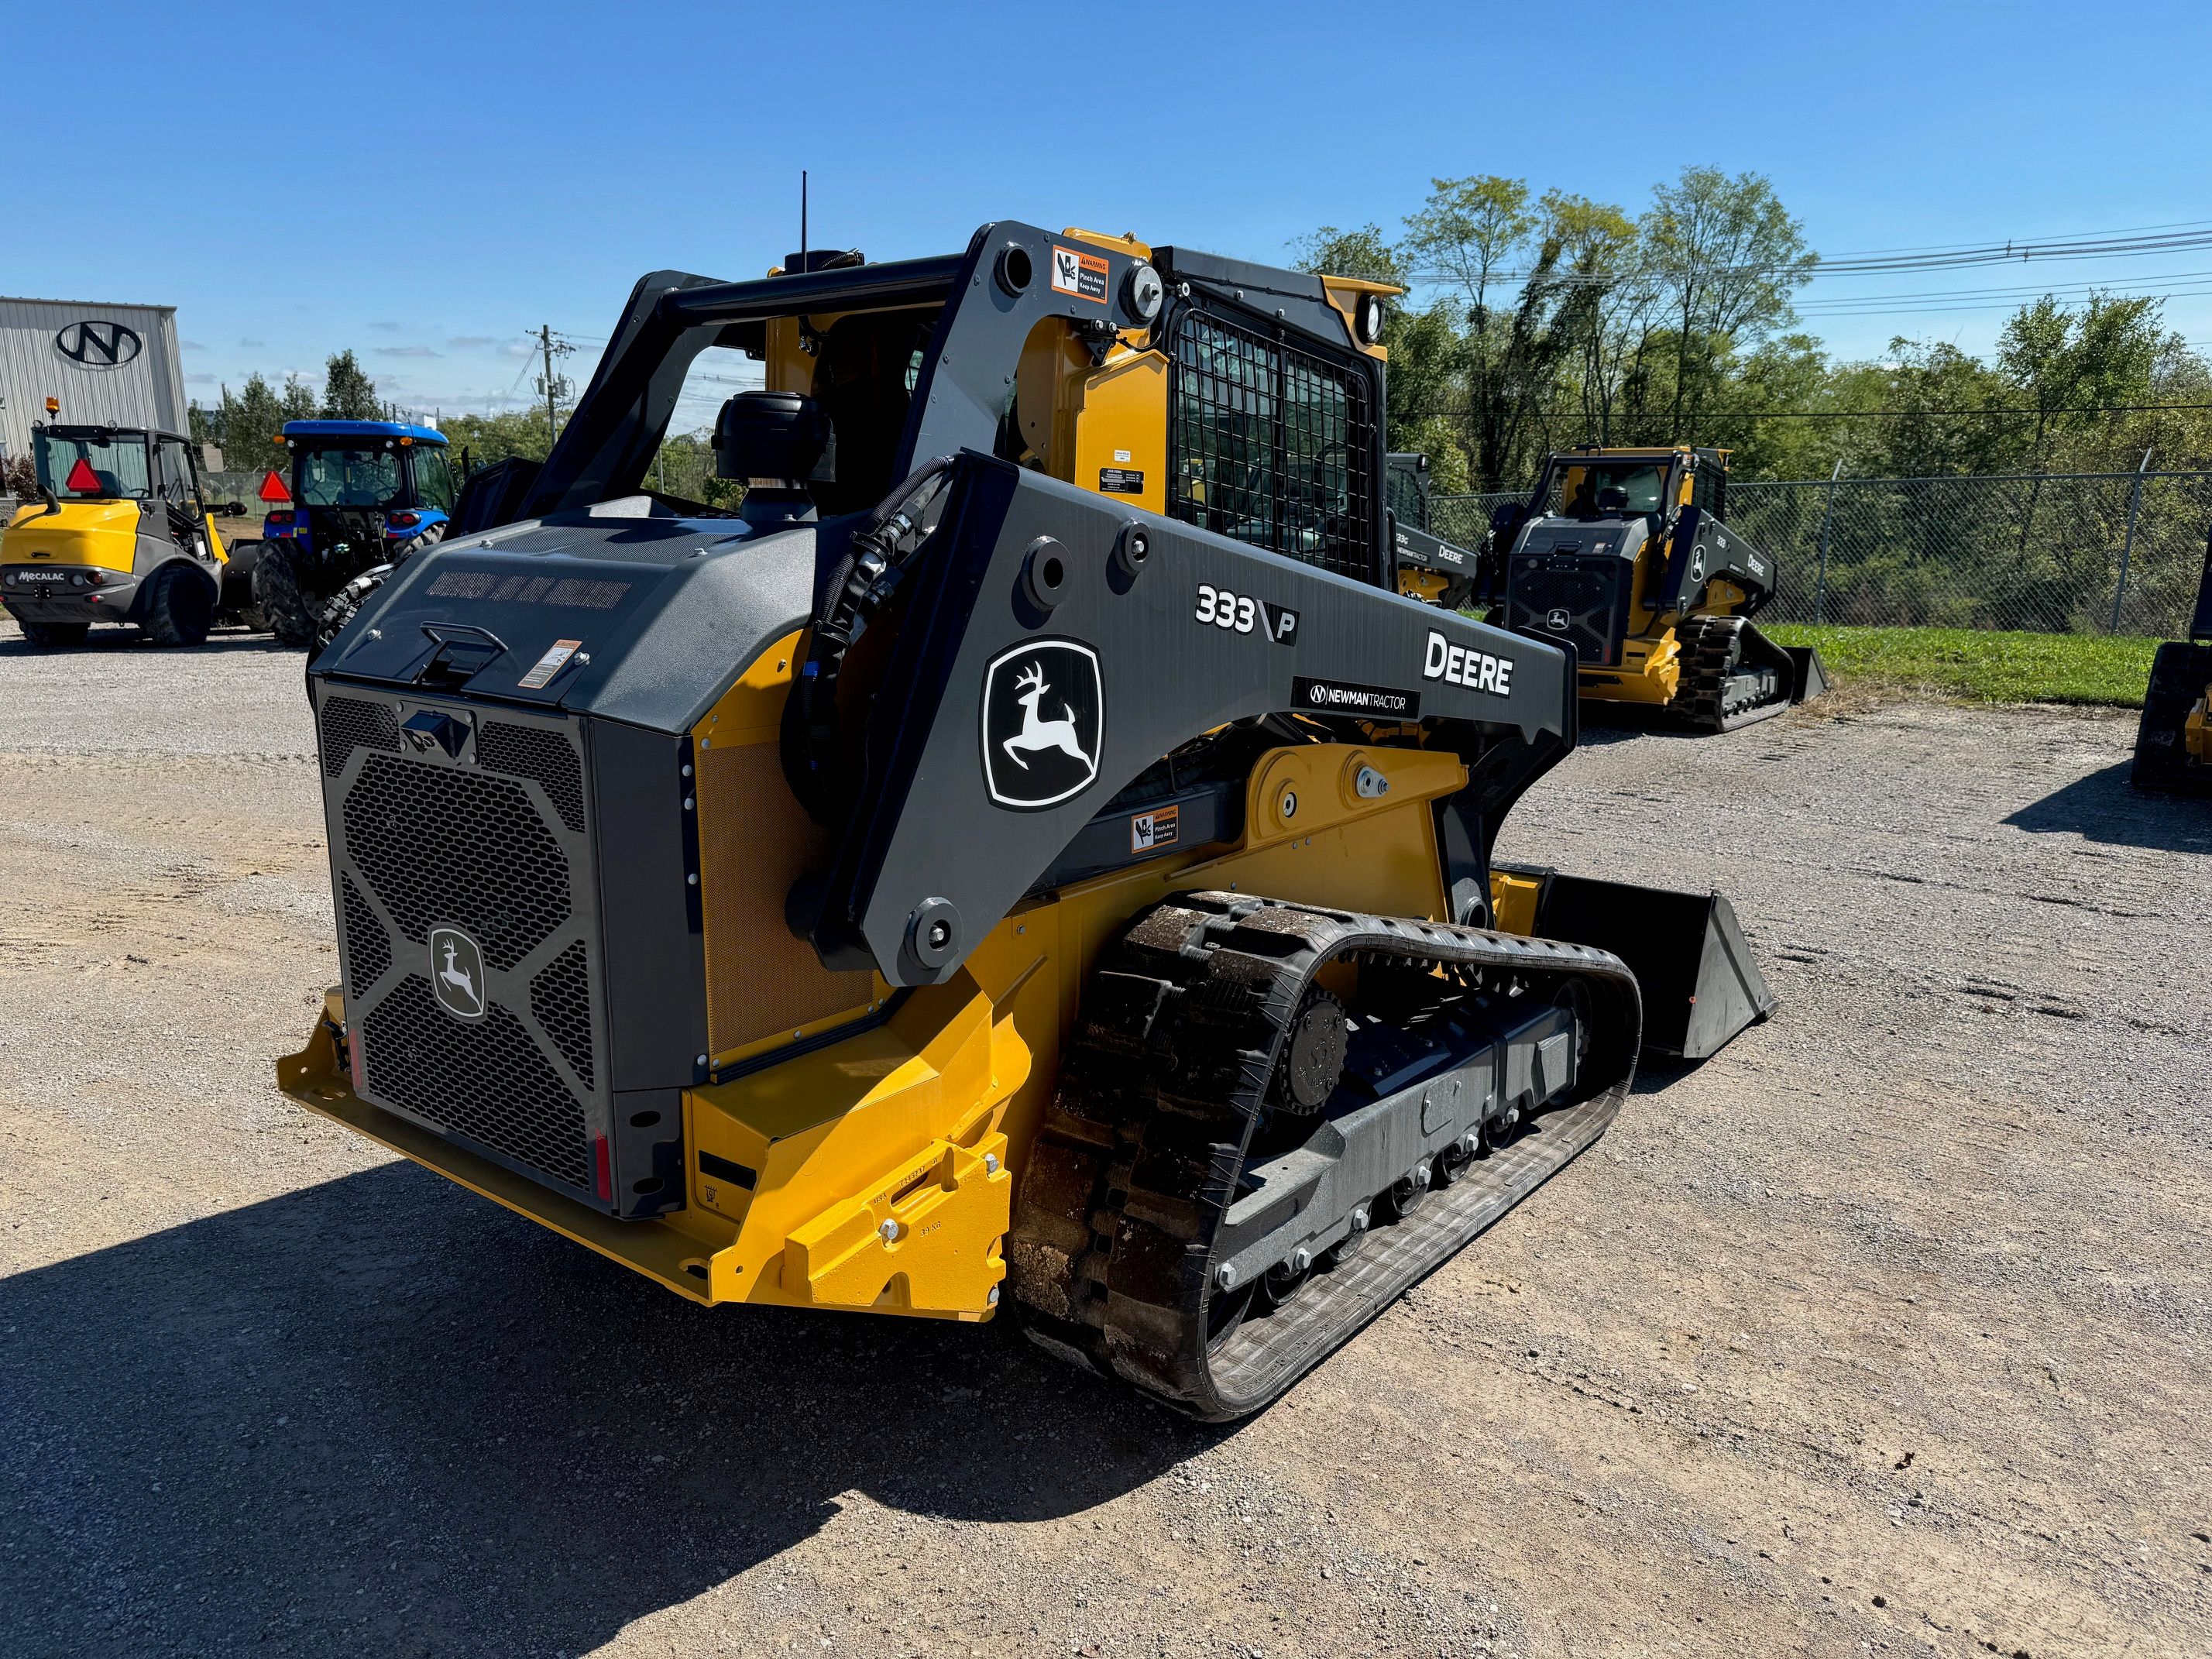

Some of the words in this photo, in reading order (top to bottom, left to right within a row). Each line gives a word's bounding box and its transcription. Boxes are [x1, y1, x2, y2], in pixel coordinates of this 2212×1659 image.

[1086, 259, 1106, 270] WARNING
[1079, 282, 1090, 290] Keep
[1090, 285, 1101, 294] Away
[1080, 273, 1093, 282] Pinch
[1094, 276, 1104, 286] Area
[71, 321, 129, 364] N
[1396, 532, 1409, 544] 33G
[1438, 544, 1464, 565] DEERE
[1747, 553, 1764, 577] DEERE
[1195, 586, 1255, 633] 333
[1424, 631, 1513, 696] DEERE
[1328, 689, 1406, 709] NEWMANTRACTOR
[874, 1192, 887, 1205] USA
[920, 1227, 929, 1237] 39
[931, 1221, 941, 1231] KG
